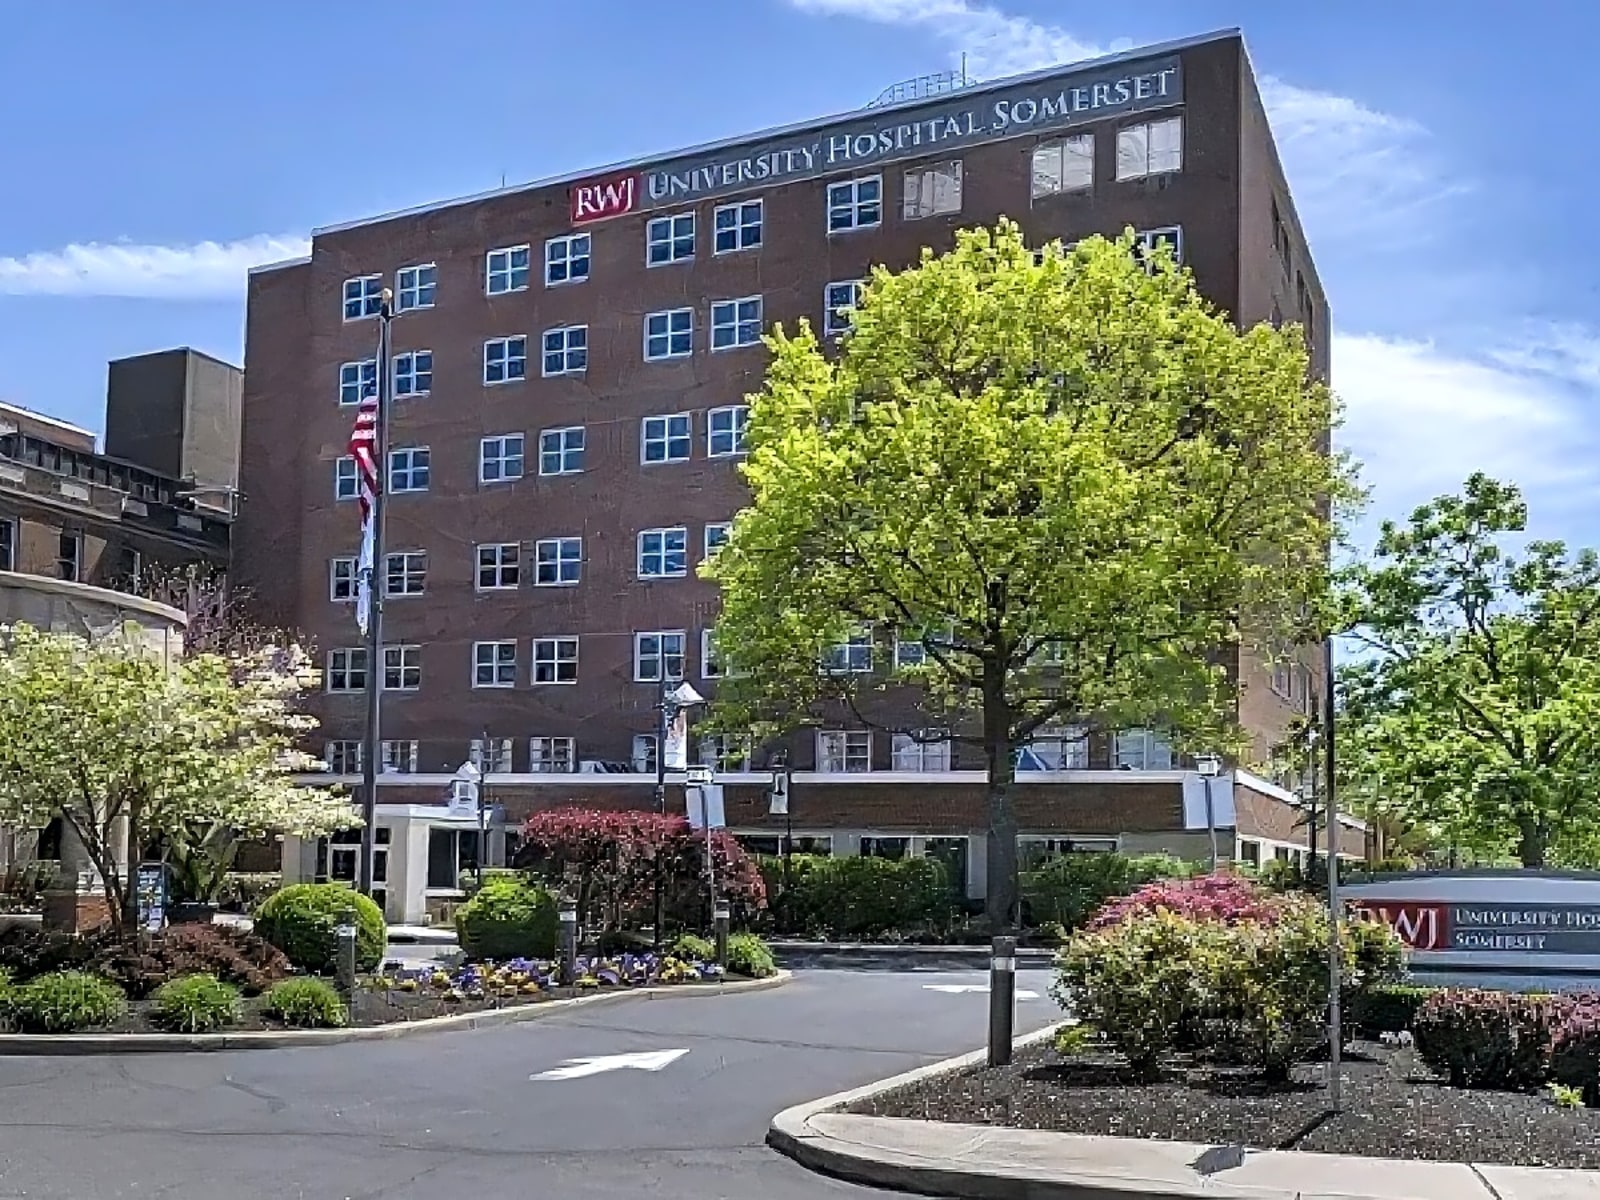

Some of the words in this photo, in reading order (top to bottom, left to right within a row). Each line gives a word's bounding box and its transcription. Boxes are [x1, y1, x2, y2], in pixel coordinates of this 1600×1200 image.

[575, 178, 634, 217] RWJ
[648, 143, 820, 200] UNIVERSITY
[826, 110, 986, 163] HOSPITAL
[992, 67, 1176, 130] SOMERSET
